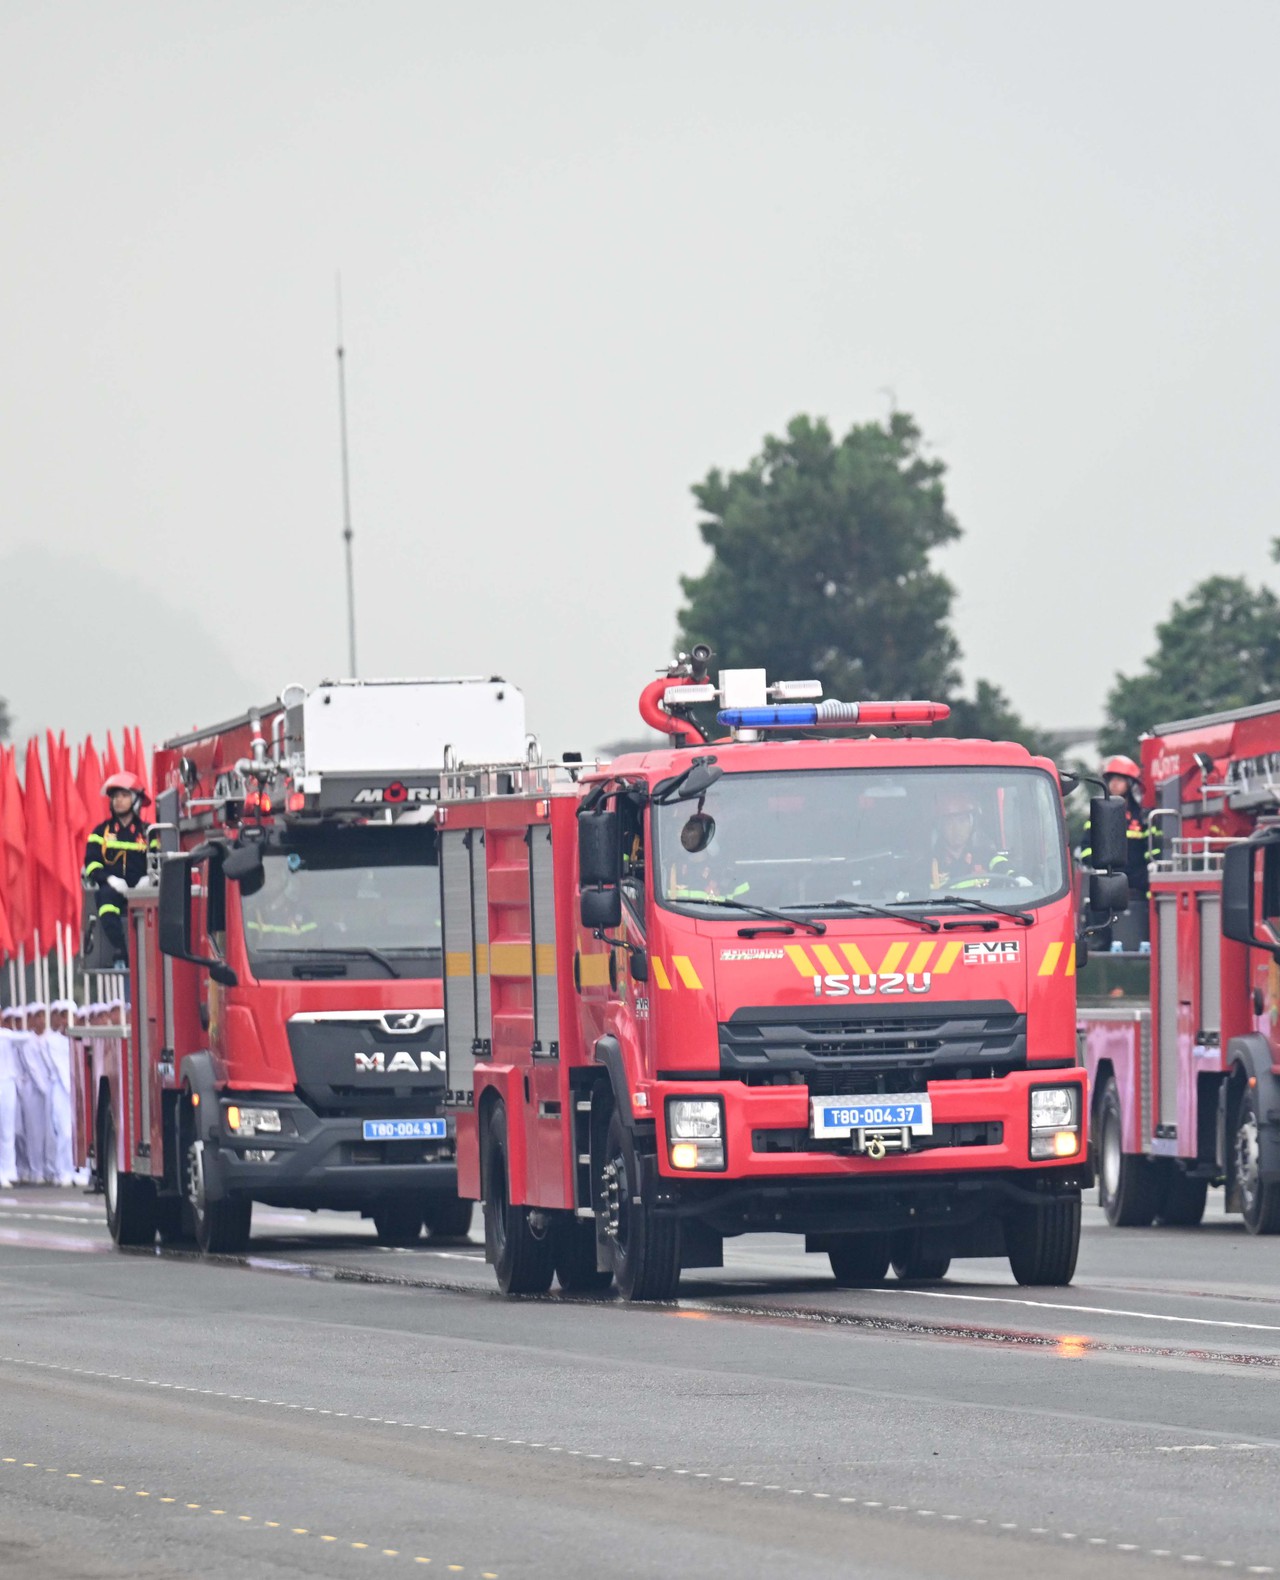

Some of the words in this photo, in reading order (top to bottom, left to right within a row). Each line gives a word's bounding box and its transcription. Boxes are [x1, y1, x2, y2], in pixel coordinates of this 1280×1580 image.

[964, 941, 1018, 953] FVR
[813, 972, 931, 997] ISUZU
[636, 998, 649, 1009] FVR
[354, 1051, 447, 1073] MAN
[830, 1107, 915, 1125] T80-004.37
